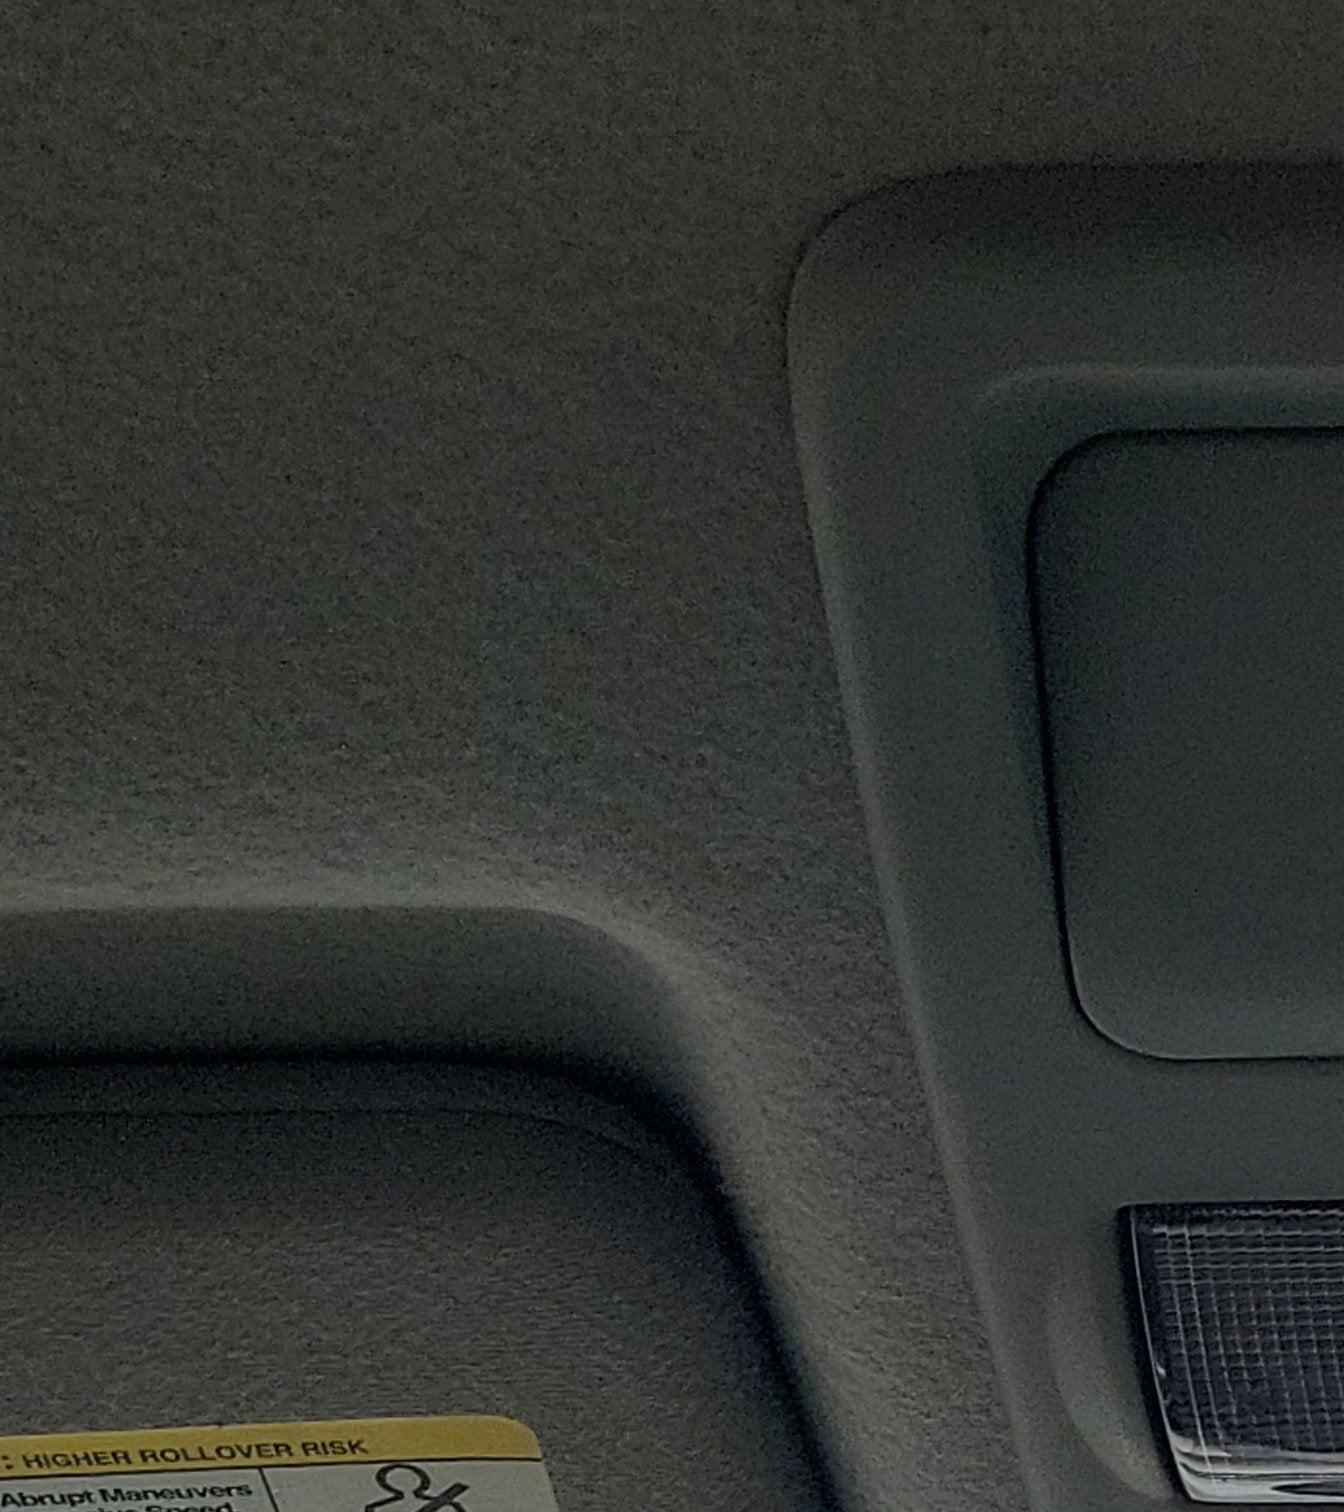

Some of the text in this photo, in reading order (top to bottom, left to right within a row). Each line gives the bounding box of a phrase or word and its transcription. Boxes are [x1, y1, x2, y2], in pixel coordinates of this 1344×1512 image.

[22, 1450, 132, 1469] HIGHER
[139, 1442, 294, 1462] ROLLOVER
[301, 1439, 368, 1457] RISK
[1, 1483, 253, 1507] Abrupt Maneuvers
